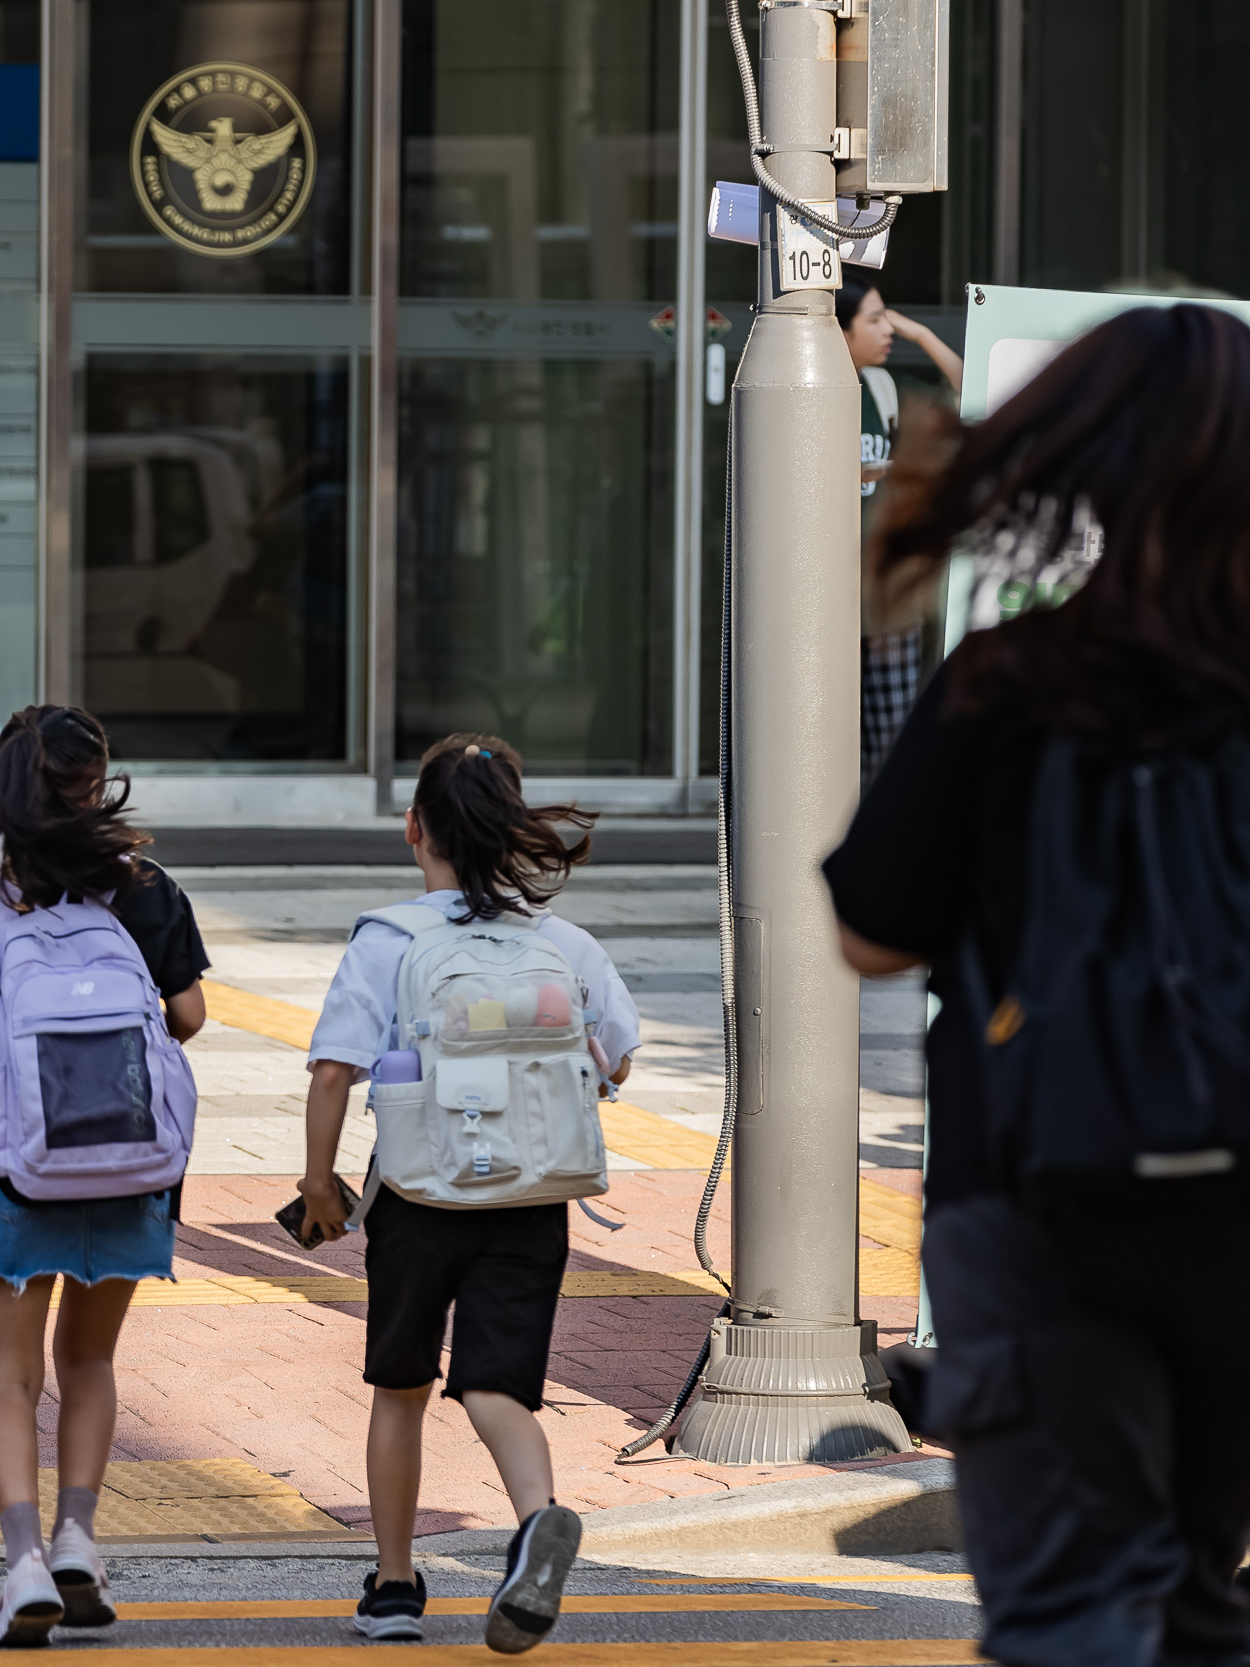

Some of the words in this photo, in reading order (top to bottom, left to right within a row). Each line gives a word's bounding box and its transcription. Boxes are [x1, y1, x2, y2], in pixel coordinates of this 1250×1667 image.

[143, 155, 165, 201] SEOUL
[234, 211, 279, 242] POLICE
[273, 157, 303, 216] STATION
[789, 249, 832, 281] 10-8
